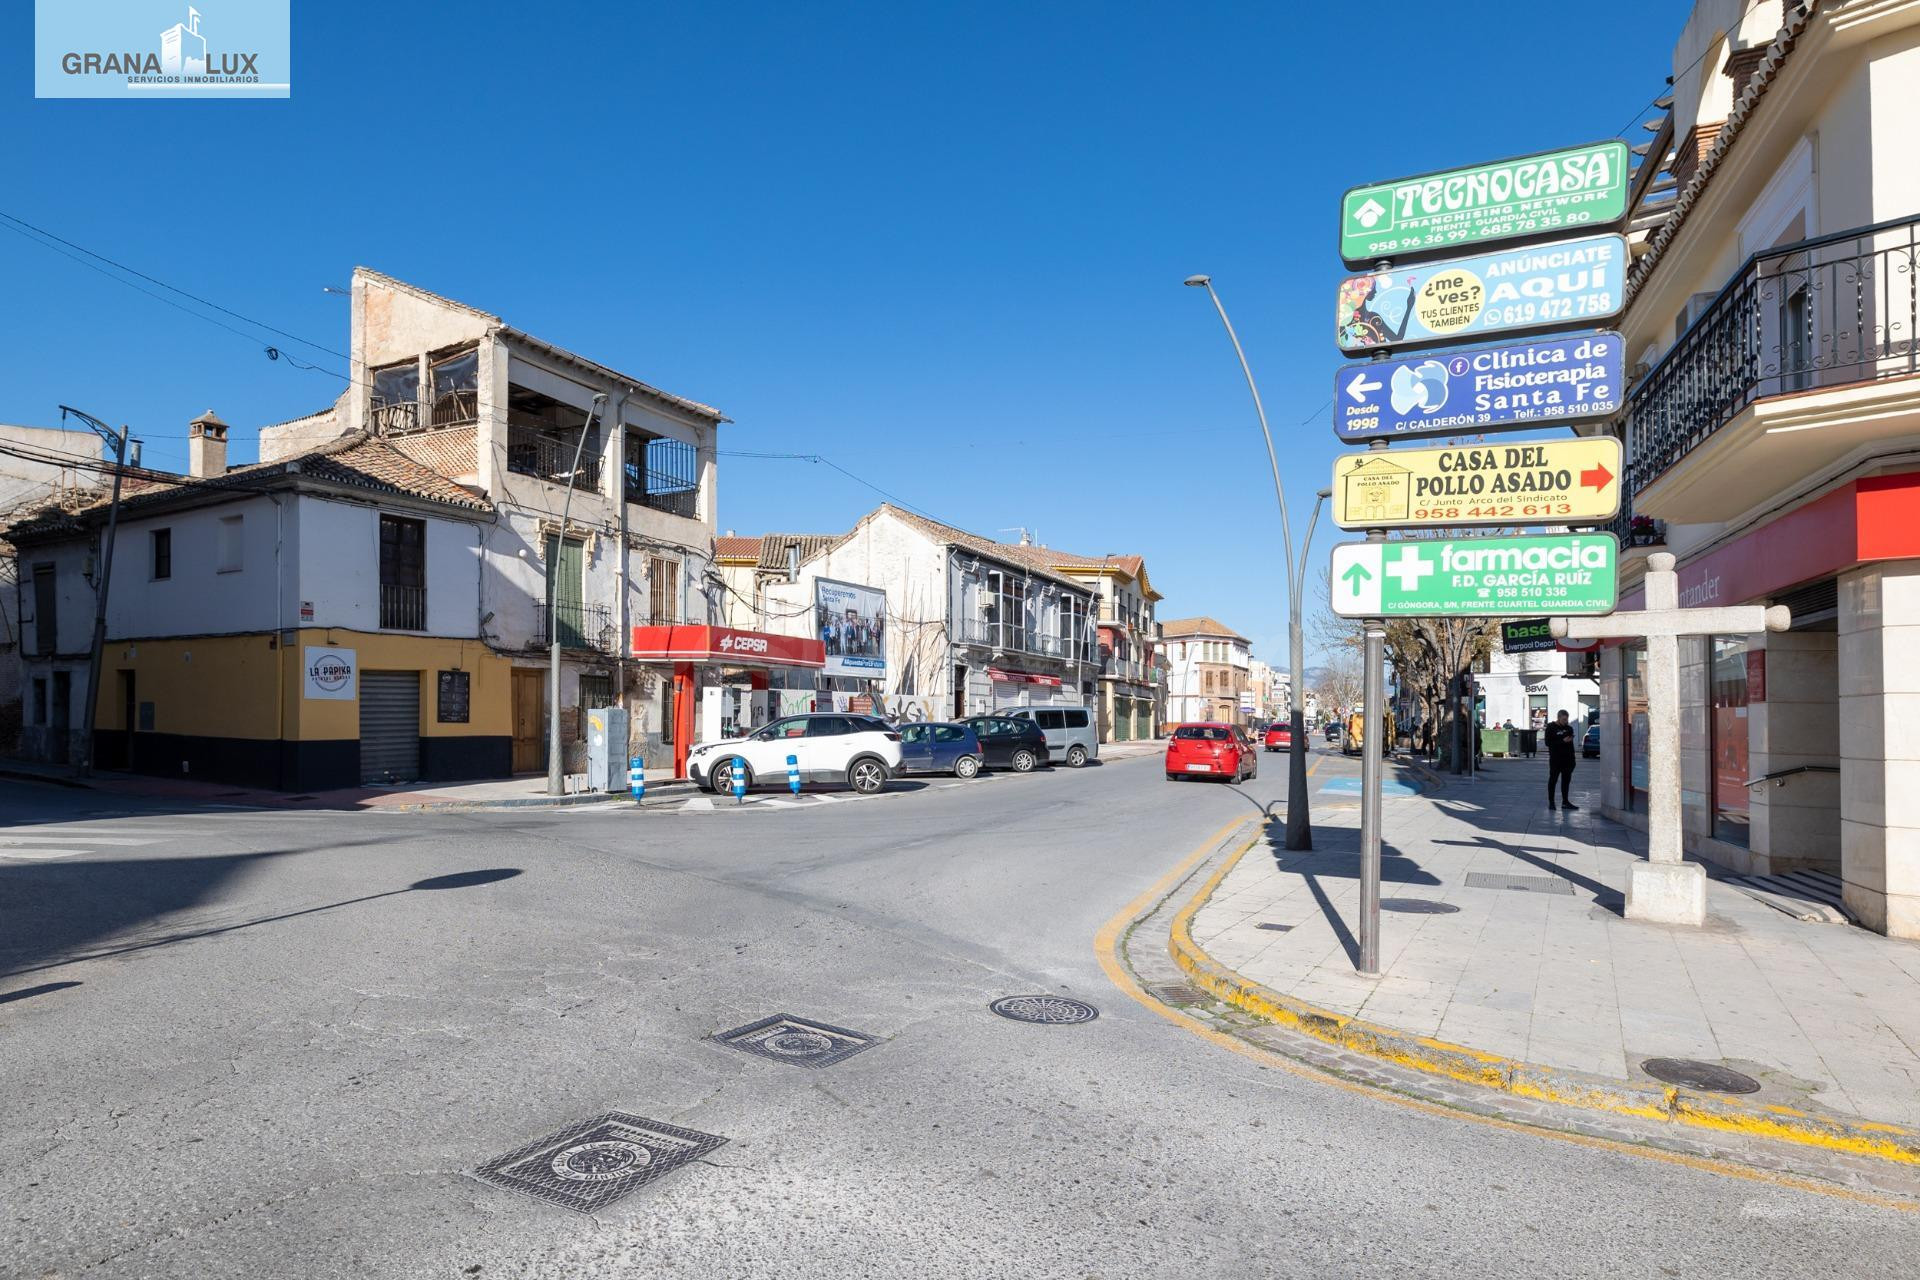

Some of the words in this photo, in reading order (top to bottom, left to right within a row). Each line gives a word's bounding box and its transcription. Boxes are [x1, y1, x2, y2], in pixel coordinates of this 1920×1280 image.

[1396, 152, 1610, 218] TECNOCASA
[1400, 205, 1513, 230] FRANCHISING
[1520, 191, 1608, 212] NETWORK
[1430, 221, 1471, 233] FRENTE
[1475, 212, 1527, 226] GUARDIA
[1529, 207, 1560, 218] CIVIL
[1368, 240, 1397, 252] 958
[1402, 236, 1421, 248] 96
[1424, 233, 1444, 244] 36
[1447, 229, 1468, 240] 99
[1480, 224, 1512, 236] 685
[1516, 220, 1536, 231] 78
[1541, 216, 1562, 228] 35
[1566, 211, 1590, 224] 80
[1486, 245, 1612, 278] ANÚNCIATE
[1425, 276, 1464, 297] ¿me
[1437, 285, 1481, 305] ves?
[1488, 266, 1605, 303] AQUÍ
[1421, 309, 1438, 319] TUS
[1439, 303, 1480, 317] CLIENTES
[1503, 302, 1536, 324] 619
[1540, 298, 1572, 320] 472
[1577, 293, 1610, 315] 758
[1430, 315, 1470, 328] TAMBIÉN
[1473, 348, 1566, 372] Clínica
[1574, 340, 1608, 358] de
[1475, 363, 1606, 391] Fisioterapia
[1475, 388, 1560, 411] Santa
[1577, 383, 1610, 401] Fe
[1346, 404, 1379, 416] Desde
[1395, 421, 1407, 431] C/
[1409, 414, 1474, 429] CALDERÓN
[1477, 413, 1490, 423] 39
[1513, 409, 1541, 420] Telf.:
[1544, 405, 1565, 416] 958
[1568, 403, 1588, 414] 510
[1592, 401, 1613, 412] 035
[1346, 417, 1378, 431] 1998
[1438, 450, 1500, 472] CASA
[1505, 447, 1548, 468] DEL
[1416, 475, 1485, 497] POLLO
[1491, 470, 1571, 493] ASADO
[1434, 498, 1463, 506] Junto
[1469, 496, 1493, 505] Arco
[1496, 495, 1513, 504] del
[1516, 494, 1568, 503] Sindicato
[1415, 507, 1459, 519] 958
[1467, 505, 1514, 518] 442
[1523, 504, 1572, 516] 613
[1441, 540, 1607, 571] farmacia
[1482, 570, 1549, 587] GARCÍA
[1555, 570, 1592, 585] RUÍZ
[1679, 569, 1720, 608] ntander
[1497, 588, 1518, 597] 958
[1521, 587, 1542, 596] 510
[1545, 587, 1568, 596] 336
[1541, 600, 1583, 608] GUARDIA
[1506, 624, 1549, 639] base
[734, 636, 767, 652] CEPSA
[1505, 641, 1534, 651] Liverpool
[310, 667, 319, 676] LA
[323, 665, 351, 675] PAPIKA
[1525, 685, 1548, 693] BBVA
